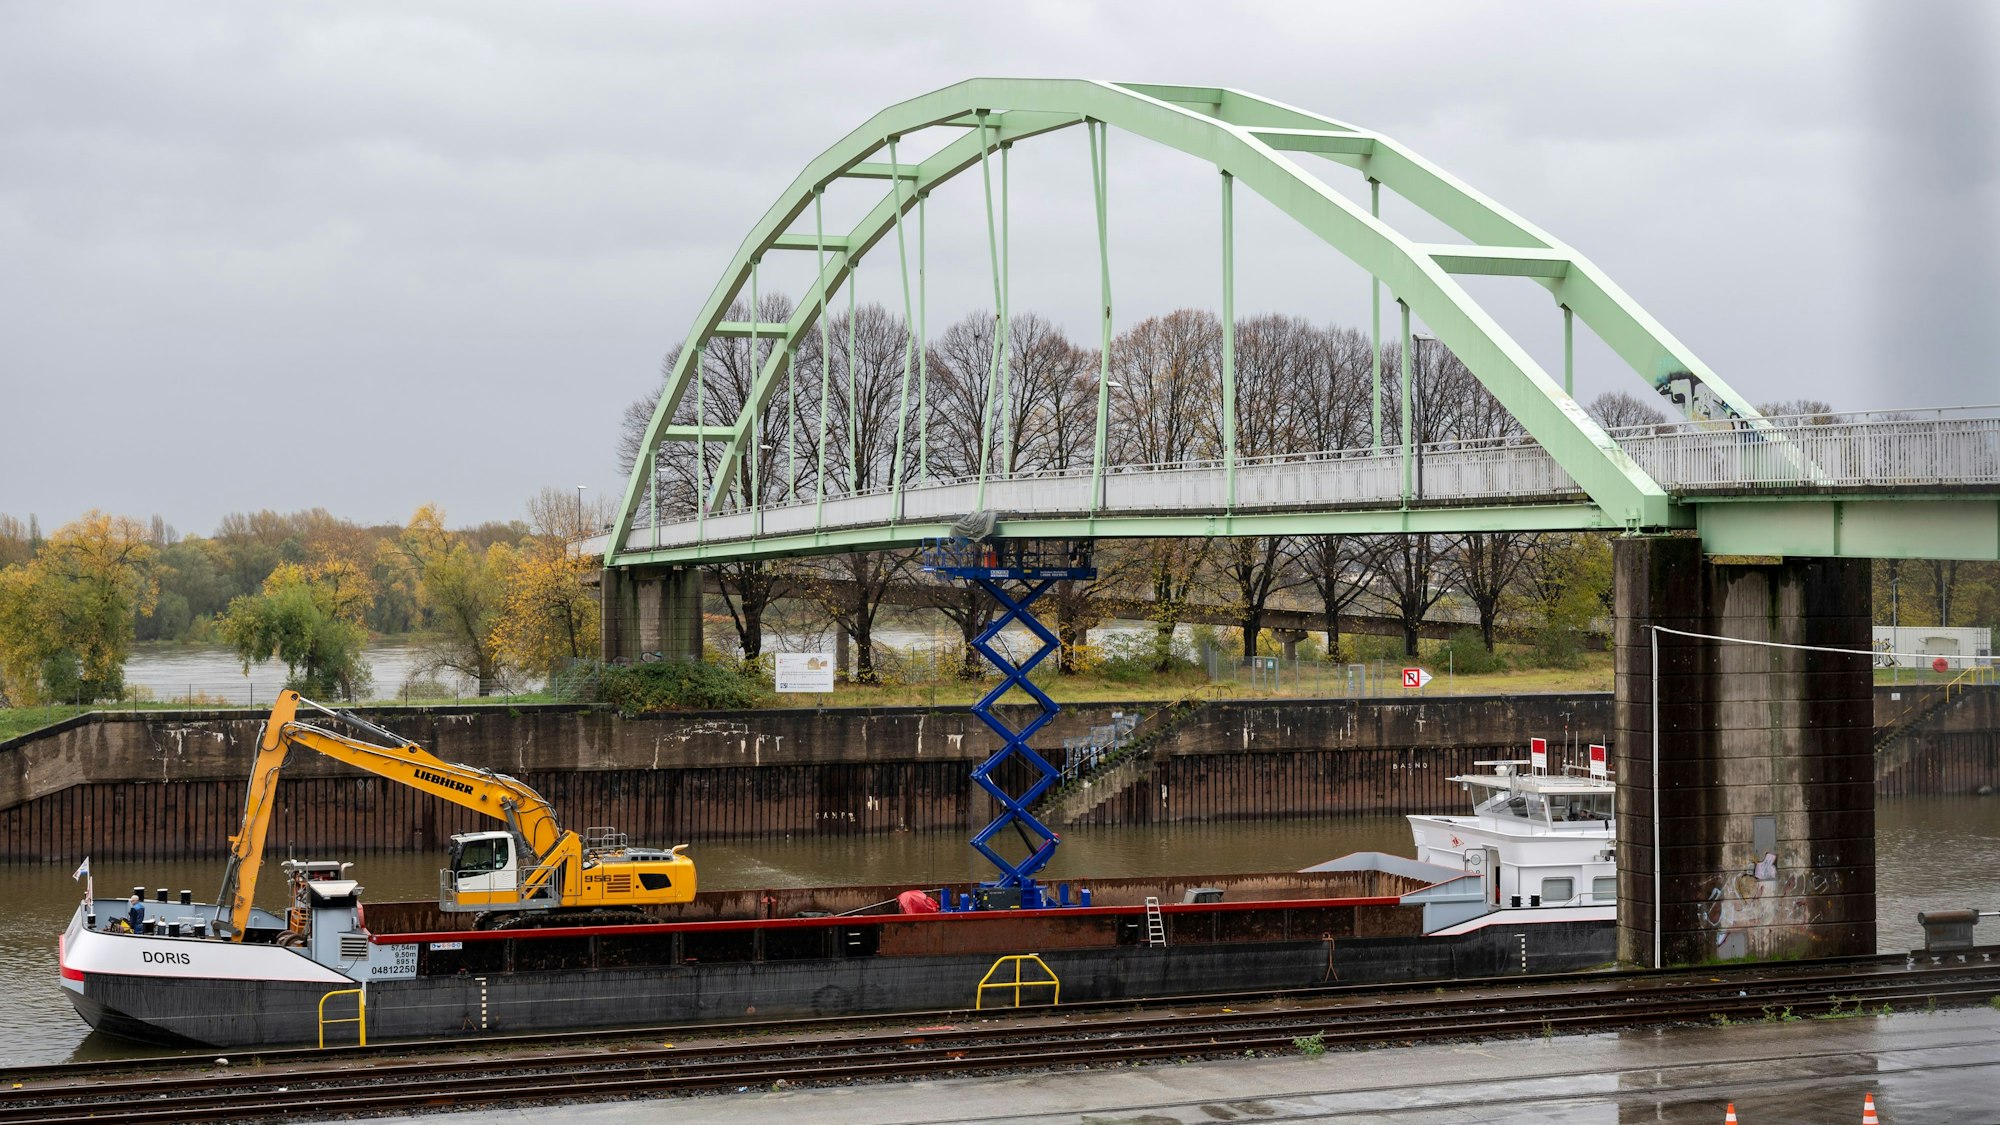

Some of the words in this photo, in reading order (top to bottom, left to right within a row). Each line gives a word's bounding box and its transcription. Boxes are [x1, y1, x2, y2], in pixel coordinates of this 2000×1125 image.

[413, 769, 474, 795] LIEBHERR
[584, 874, 612, 883] 956
[142, 951, 191, 965] DORIS
[371, 965, 415, 974] 04812250
